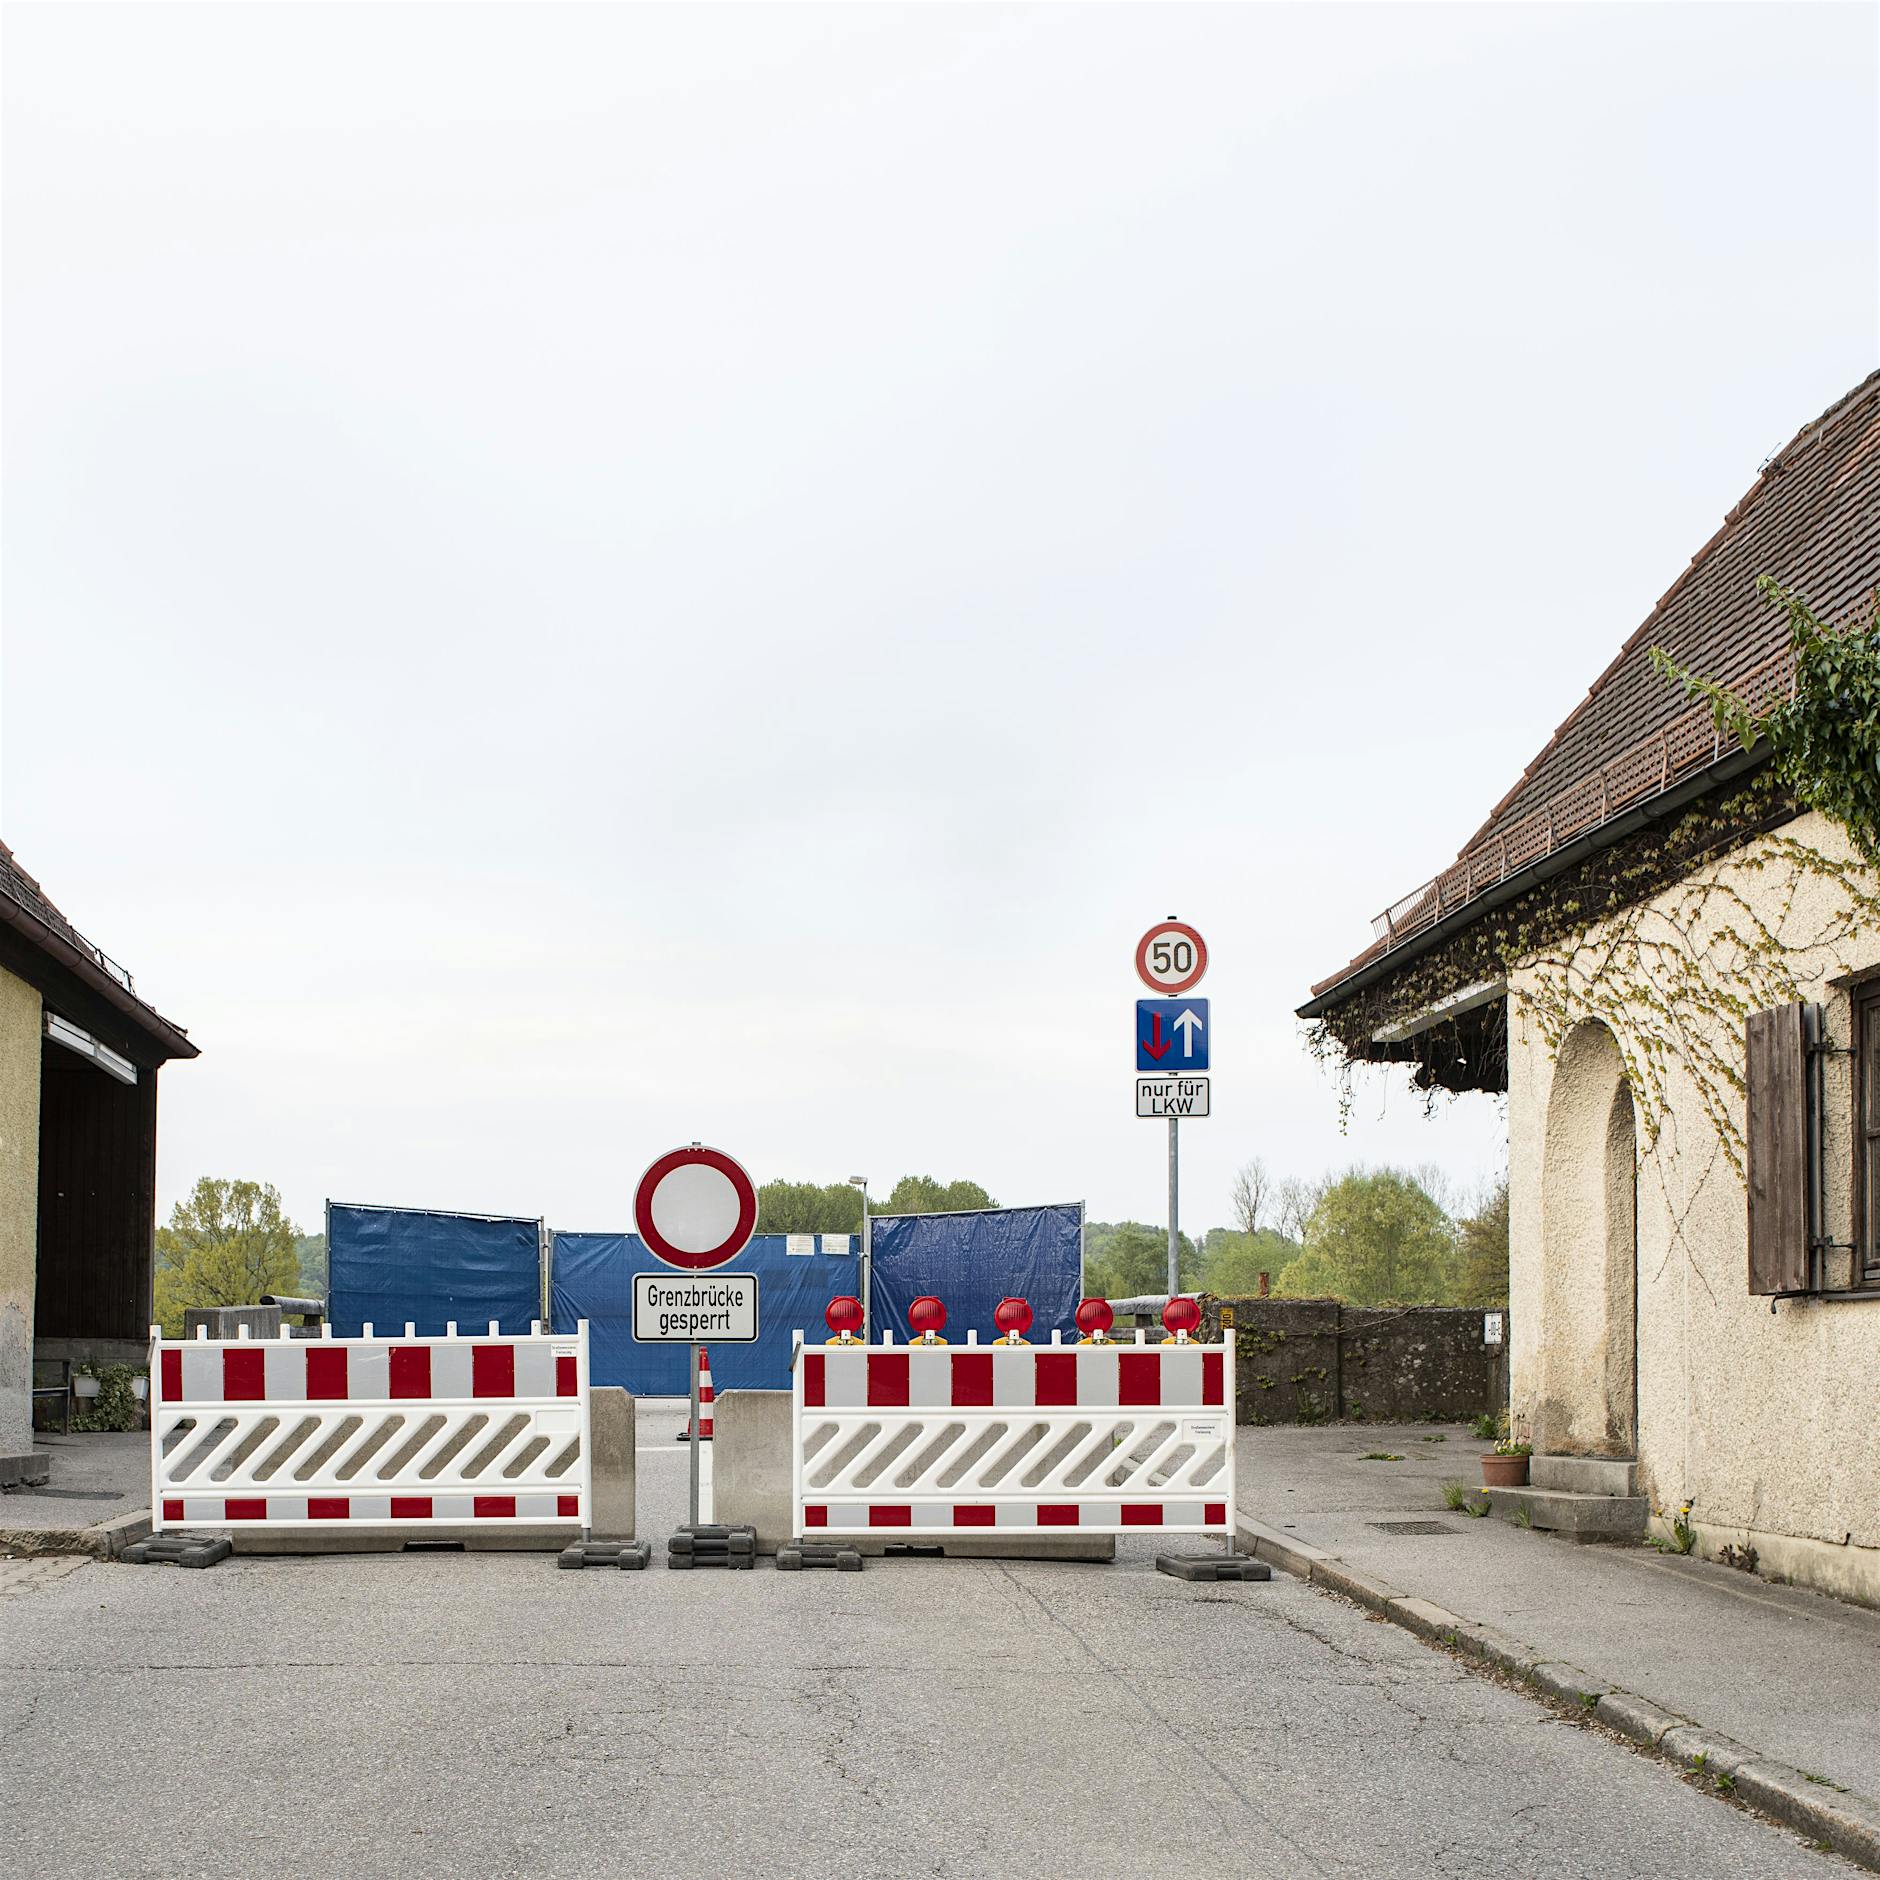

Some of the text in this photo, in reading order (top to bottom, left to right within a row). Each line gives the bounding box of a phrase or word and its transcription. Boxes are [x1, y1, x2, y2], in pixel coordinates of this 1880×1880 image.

[1153, 941, 1192, 974] 50
[1142, 1080, 1203, 1097] nur für
[1152, 1098, 1194, 1114] LKW
[648, 1285, 743, 1307] Grenzbrücke
[660, 1310, 730, 1335] gesperrt
